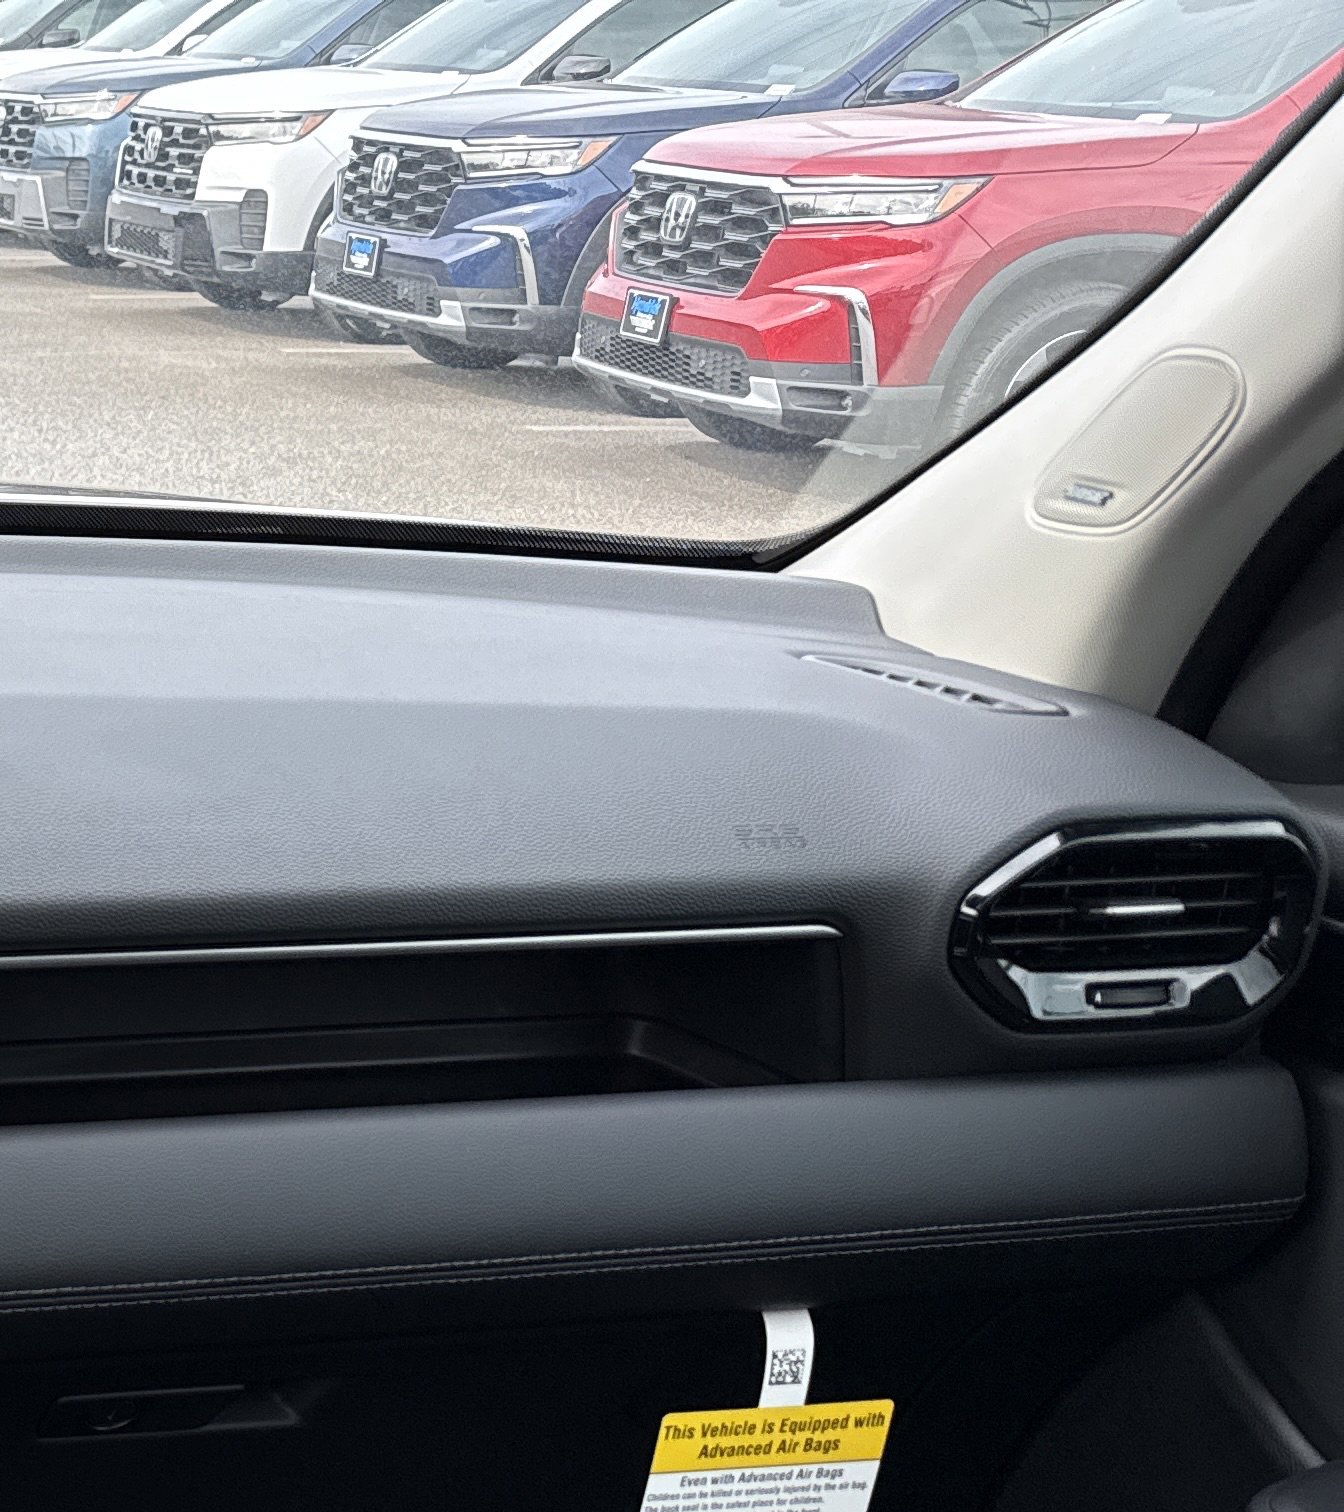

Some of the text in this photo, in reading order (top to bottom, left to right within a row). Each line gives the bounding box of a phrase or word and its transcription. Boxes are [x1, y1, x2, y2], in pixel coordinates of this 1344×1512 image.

[663, 1424, 696, 1441] This
[700, 1421, 756, 1439] Vehicle
[778, 1413, 849, 1437] Equipped
[853, 1411, 886, 1429] with
[697, 1435, 841, 1459] Advanced Air Bags
[679, 1467, 844, 1488] Even with Advanced Air Bags
